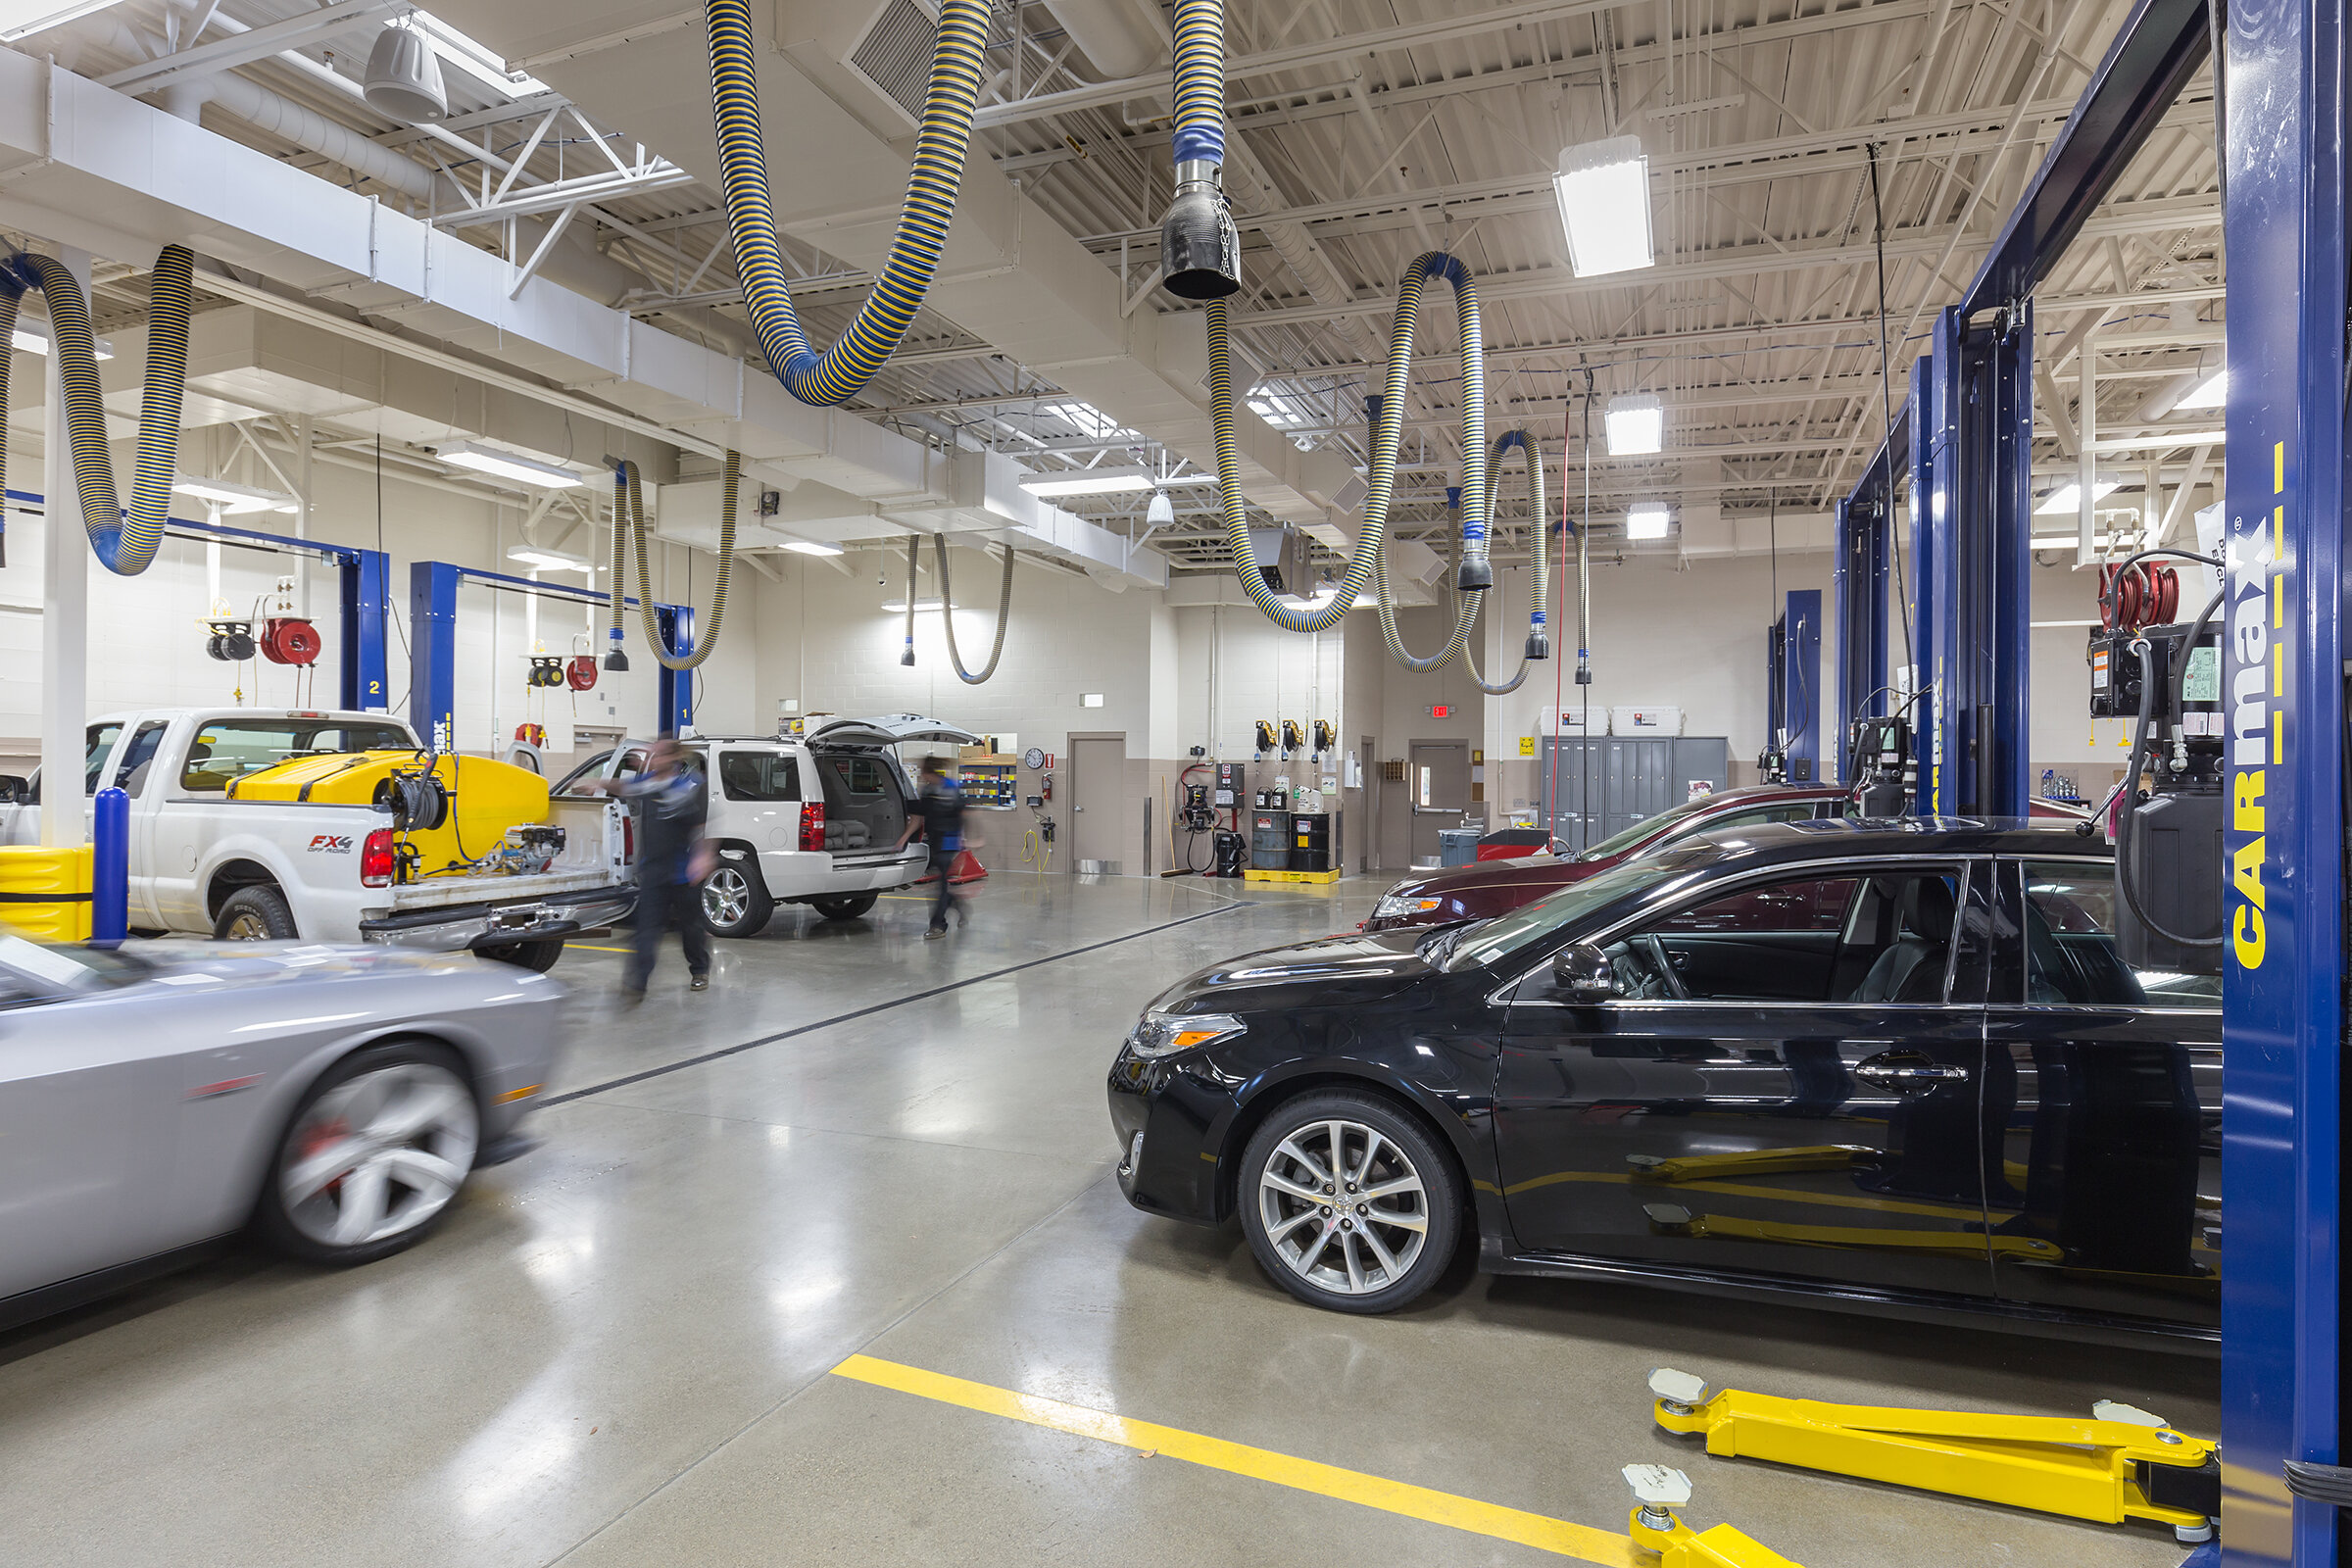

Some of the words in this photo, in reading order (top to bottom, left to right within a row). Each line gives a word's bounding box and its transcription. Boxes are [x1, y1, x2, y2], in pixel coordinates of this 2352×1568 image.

[2211, 548, 2226, 587] ECL
[369, 681, 379, 694] 2
[682, 708, 688, 719] 1
[1433, 705, 1448, 718] EXIT
[1932, 678, 1940, 817] ARmax
[2233, 515, 2267, 970] CARmax
[310, 836, 354, 849] FX4
